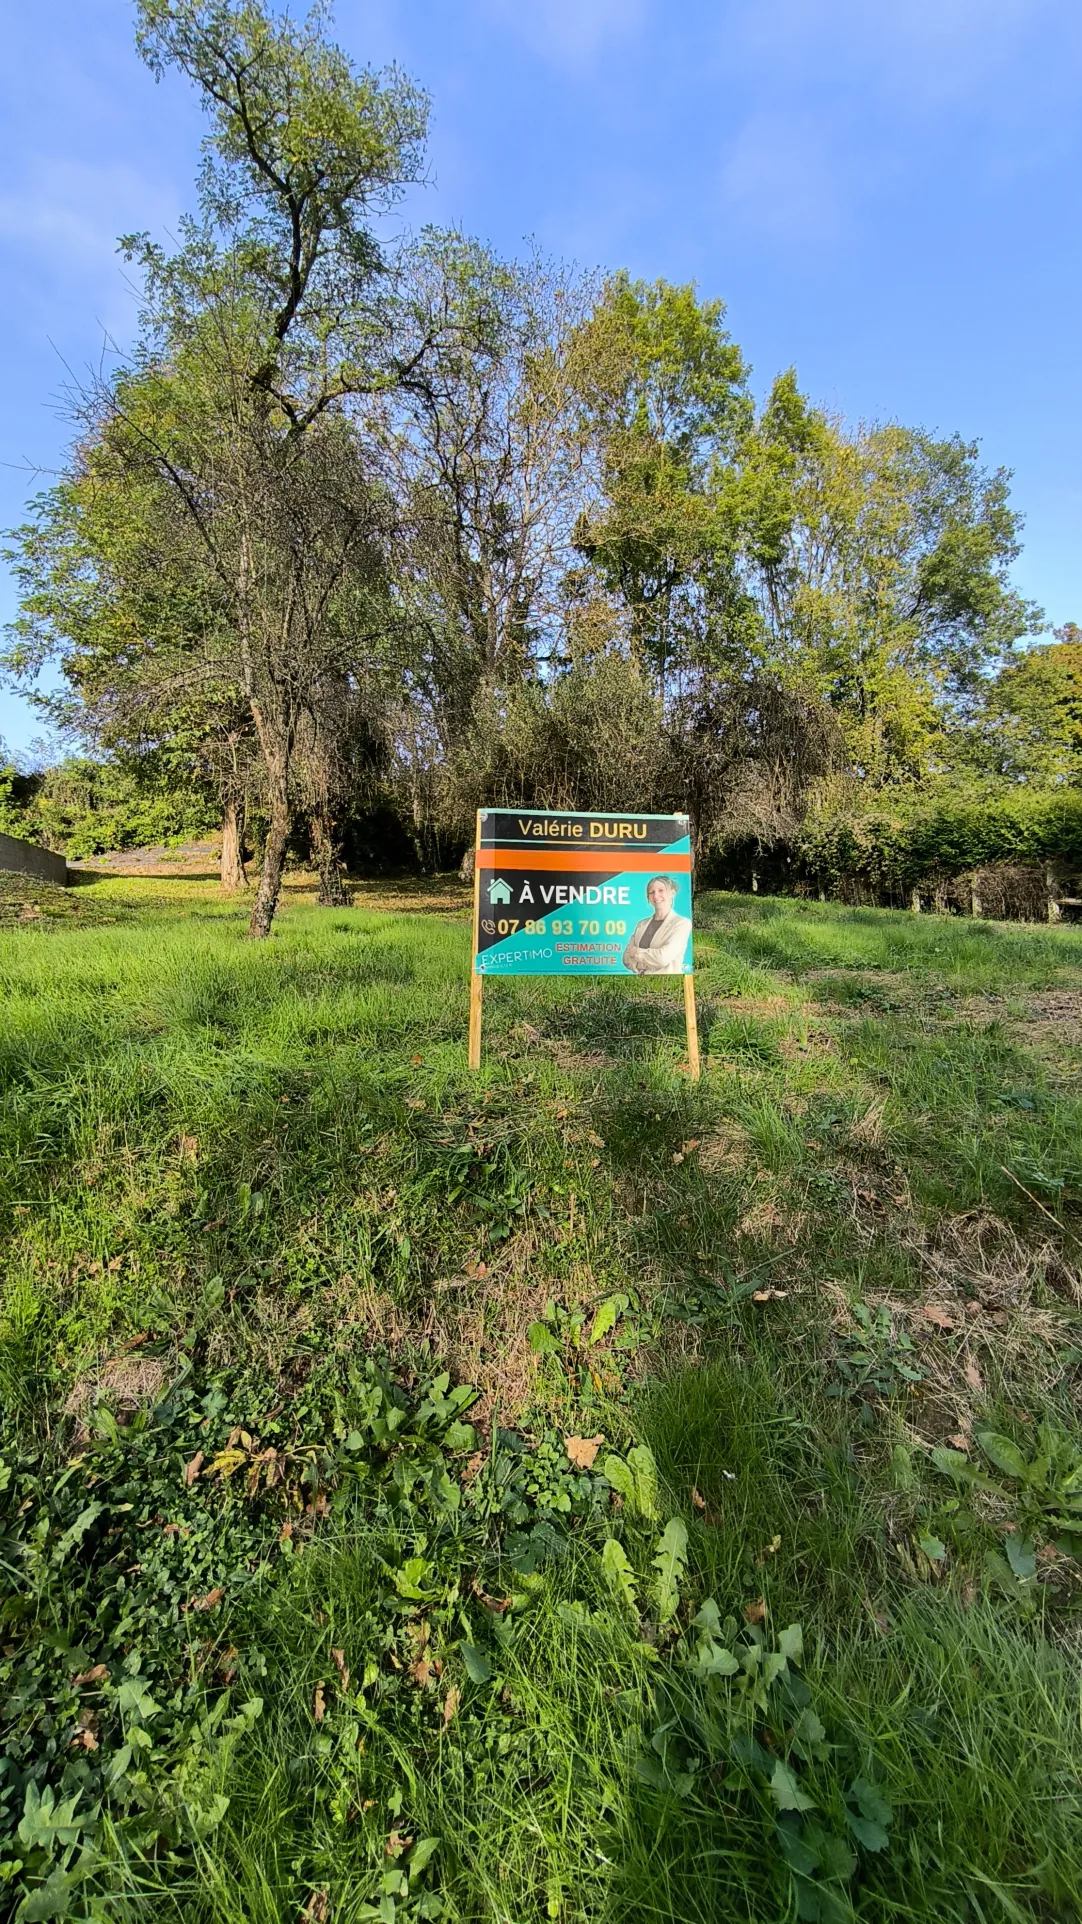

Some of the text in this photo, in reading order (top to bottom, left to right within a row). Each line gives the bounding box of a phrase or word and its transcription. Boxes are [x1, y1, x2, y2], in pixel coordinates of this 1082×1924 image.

[518, 819, 648, 839] Valérie DURU
[519, 879, 631, 905] À VENDRE
[497, 919, 627, 936] 07 86 93 70 09
[555, 942, 622, 952] ESTIMATION
[481, 948, 553, 966] EXPERTIMO
[562, 956, 617, 966] GRATUITE
